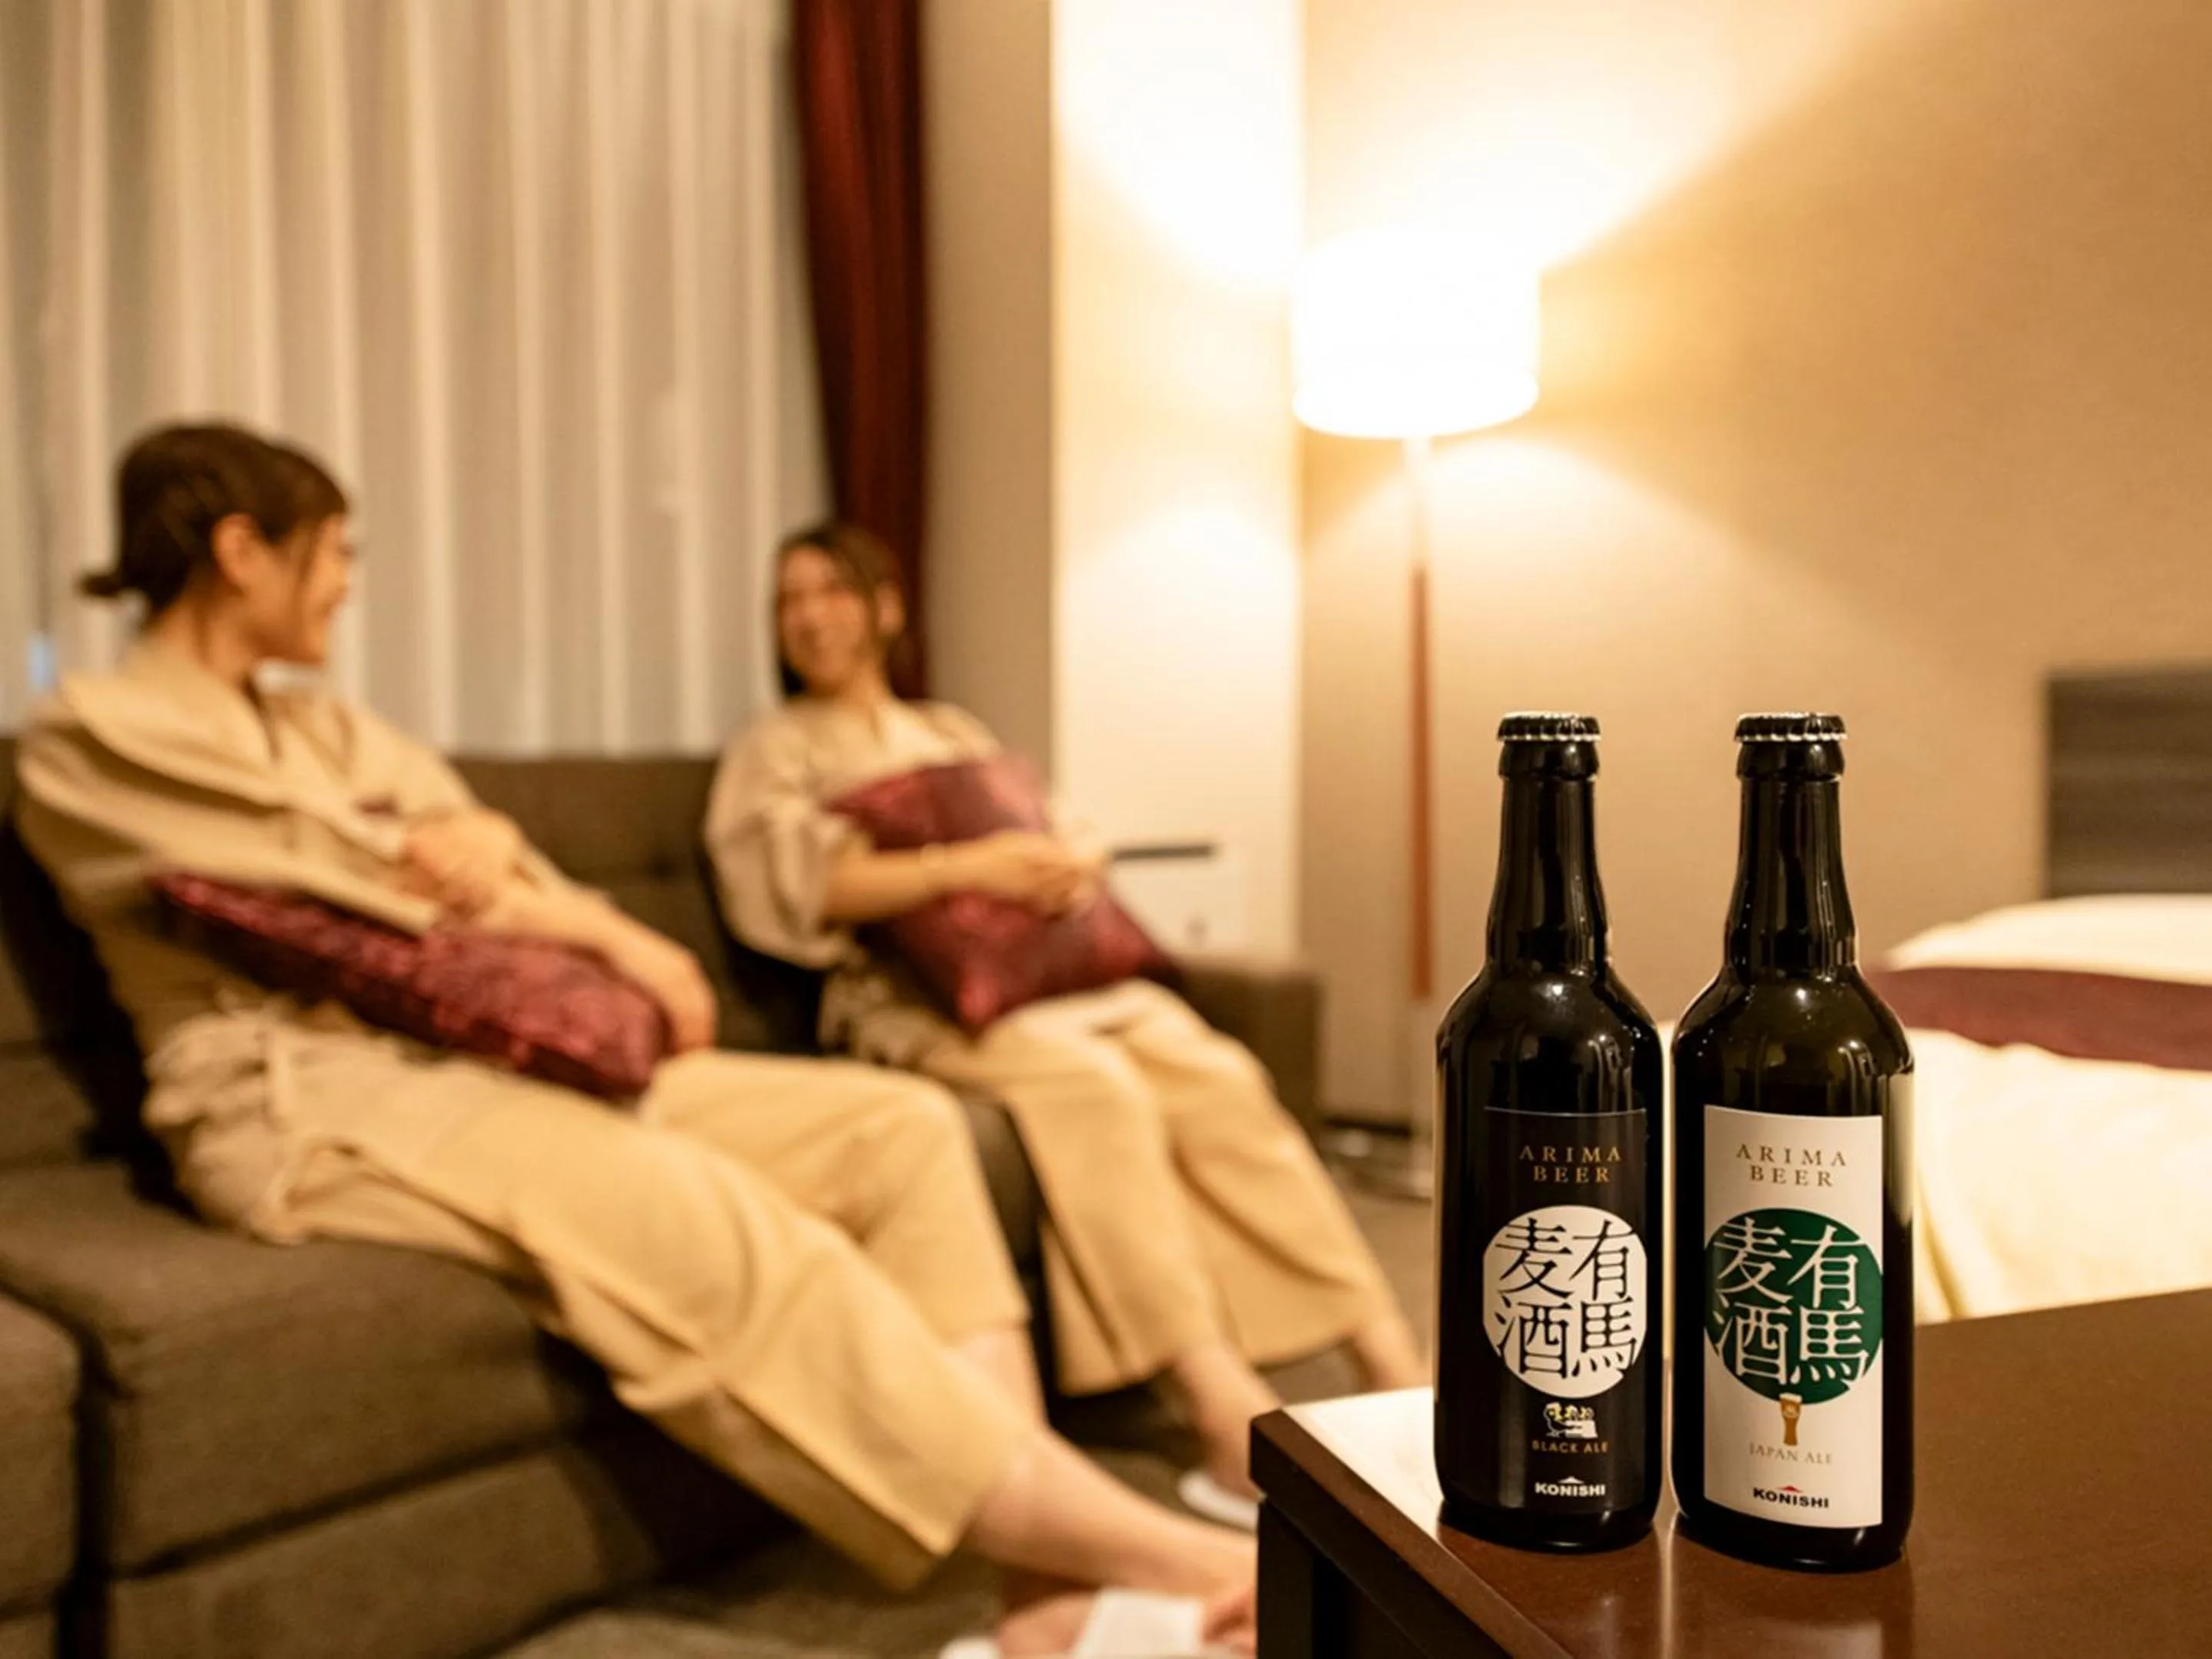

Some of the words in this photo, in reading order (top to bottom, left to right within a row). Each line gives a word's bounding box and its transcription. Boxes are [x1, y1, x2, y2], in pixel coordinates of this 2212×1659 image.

[1519, 1144, 1621, 1162] ARIMA
[1736, 1143, 1846, 1167] ARIMA
[1534, 1165, 1610, 1184] BEER
[1750, 1165, 1833, 1187] BEER
[1532, 1439, 1578, 1454] BLACK
[1583, 1441, 1609, 1454] ALE
[1749, 1441, 1799, 1462] JAPAN
[1806, 1452, 1833, 1465] ALE
[1535, 1482, 1607, 1497] KONISHI
[1753, 1487, 1830, 1508] KONISHI
